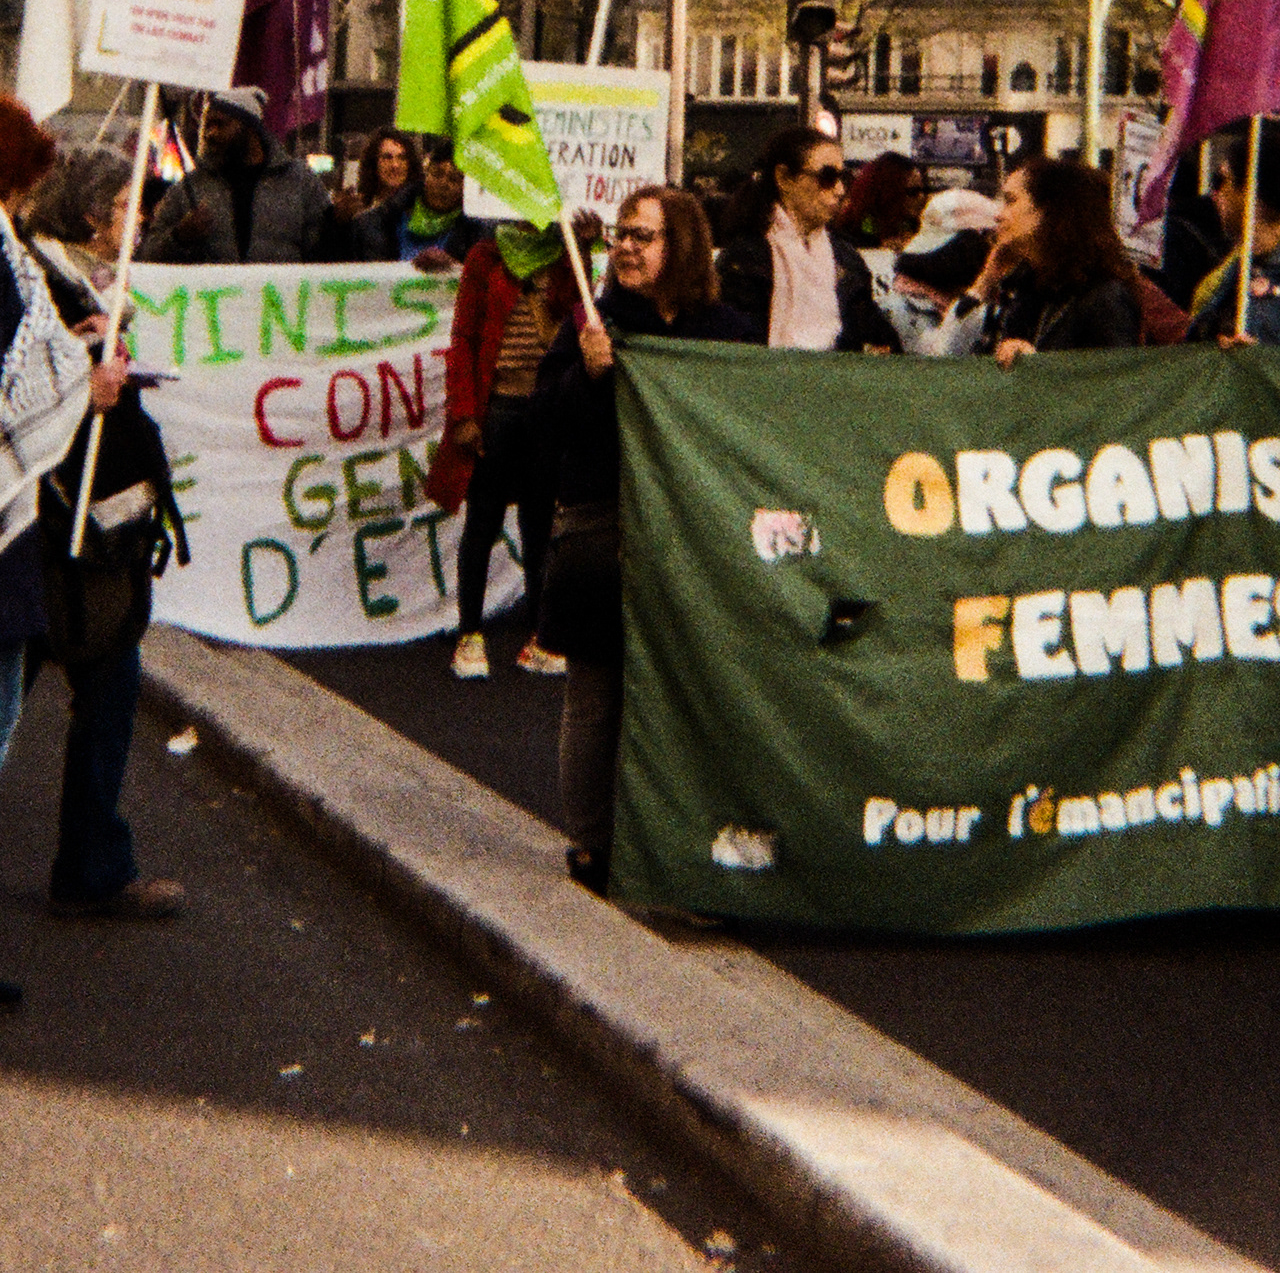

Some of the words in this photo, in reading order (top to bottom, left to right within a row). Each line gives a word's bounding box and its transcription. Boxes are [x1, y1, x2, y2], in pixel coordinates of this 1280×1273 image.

[127, 277, 461, 368] MINIS
[253, 348, 456, 449] CON
[281, 439, 442, 532] GEN
[863, 795, 982, 846] Pour
